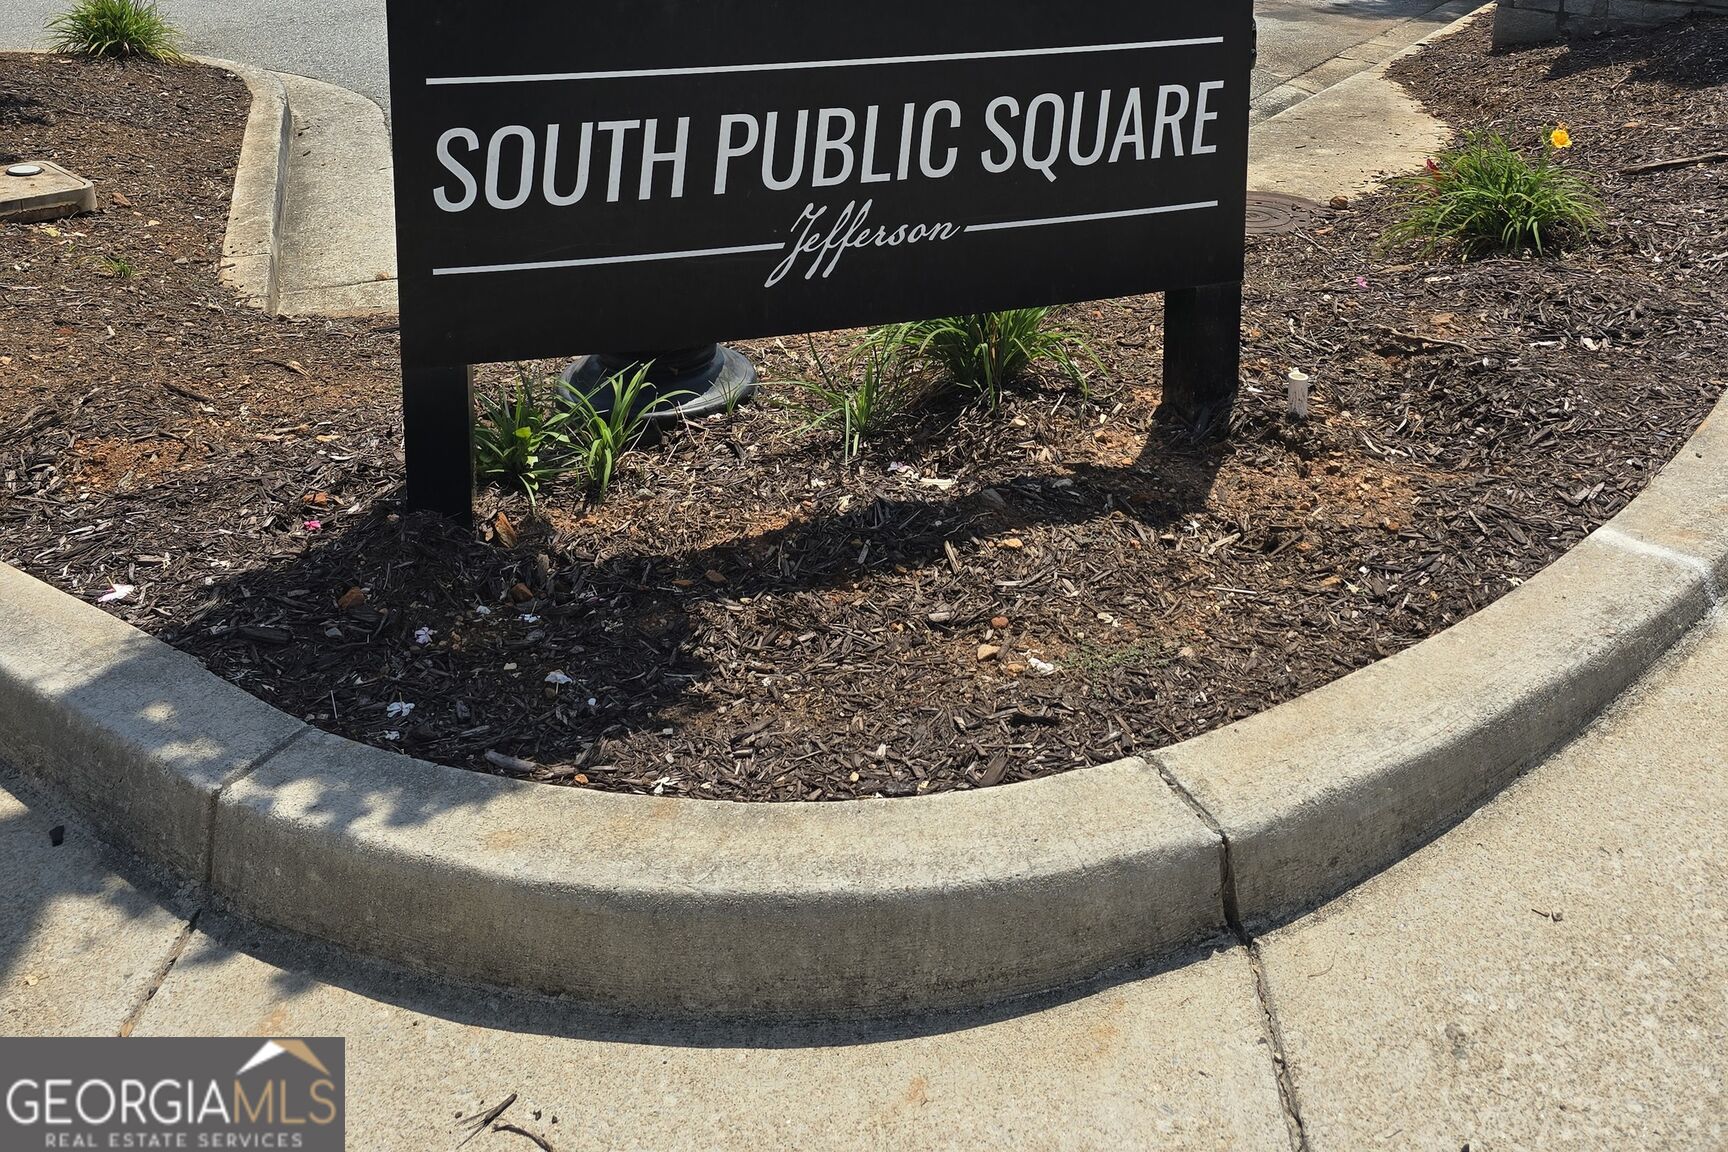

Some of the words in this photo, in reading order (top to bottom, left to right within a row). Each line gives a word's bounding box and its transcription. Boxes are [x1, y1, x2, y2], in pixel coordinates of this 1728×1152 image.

[433, 116, 690, 213] SOUTH
[713, 99, 961, 196] PUBLIC
[981, 80, 1225, 183] SQUARE
[764, 198, 961, 288] Jefferson
